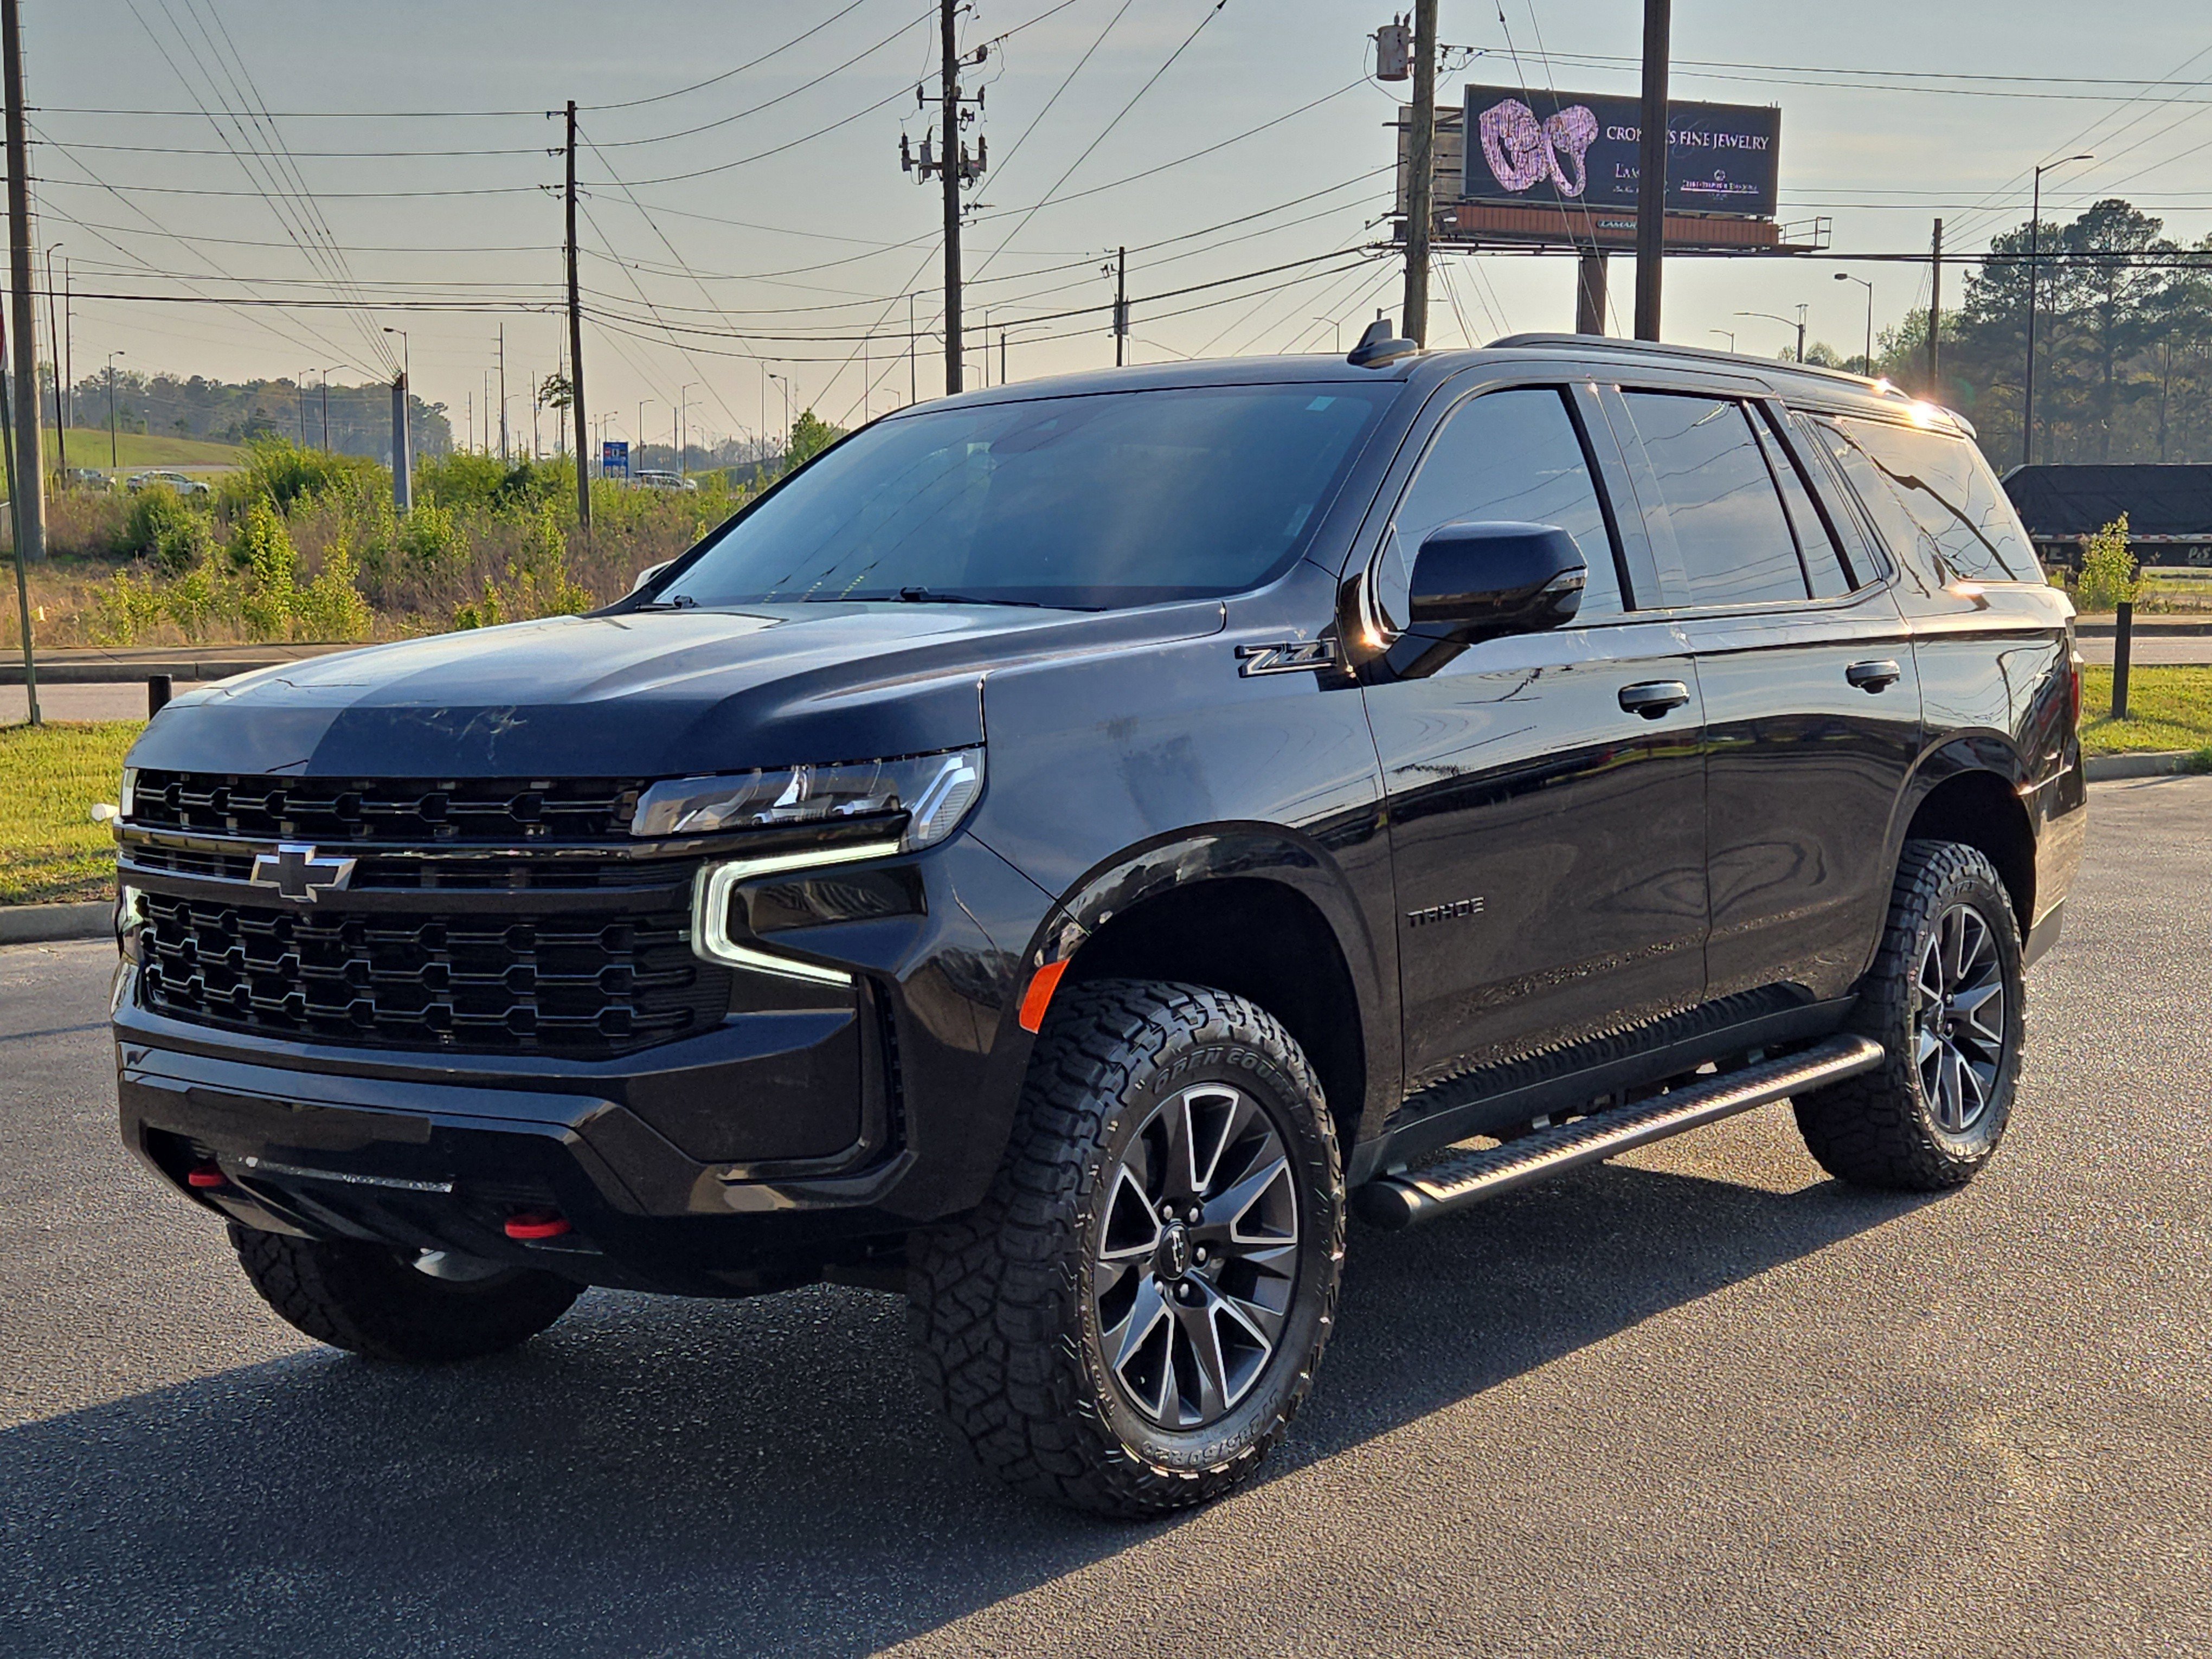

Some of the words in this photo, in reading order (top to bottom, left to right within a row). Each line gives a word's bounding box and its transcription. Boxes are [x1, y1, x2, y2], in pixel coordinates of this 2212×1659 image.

[1680, 131, 1710, 146] FINE
[1713, 133, 1769, 150] JEWELRY
[1234, 637, 1338, 678] Z71
[1406, 896, 1486, 927] TAHOE
[1154, 1046, 1224, 1095] OPEN
